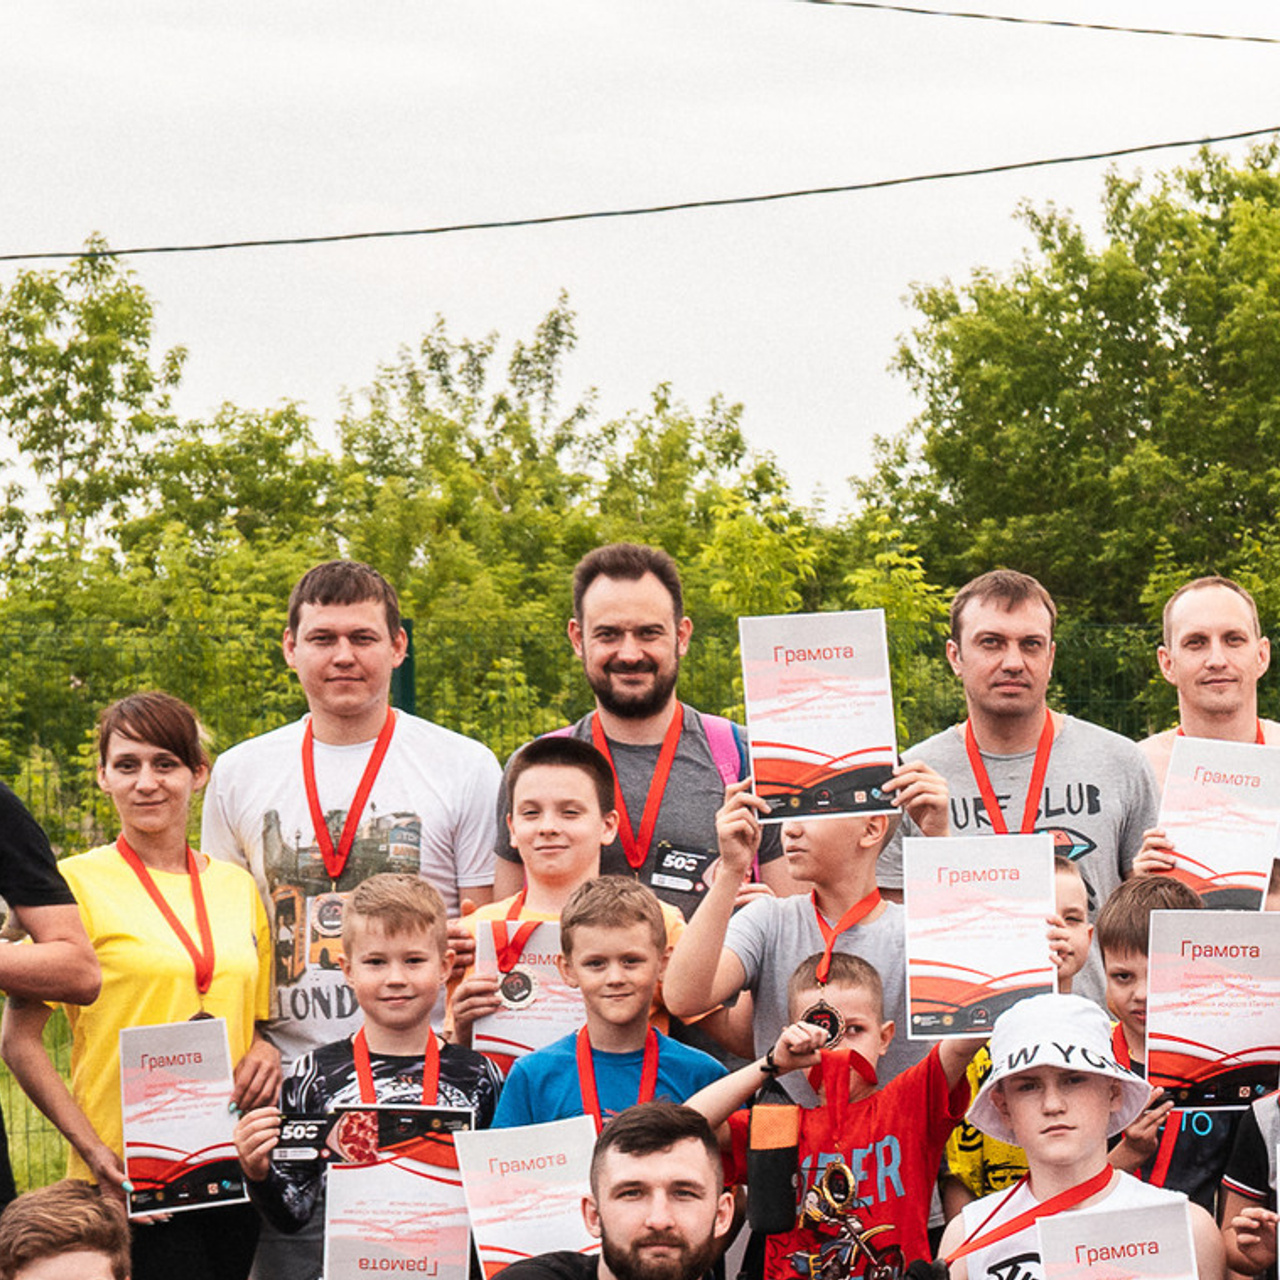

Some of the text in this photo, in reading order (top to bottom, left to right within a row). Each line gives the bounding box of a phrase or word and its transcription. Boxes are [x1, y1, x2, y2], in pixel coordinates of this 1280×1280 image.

[774, 646, 854, 667] Грамота
[1194, 766, 1261, 788] Грамота
[938, 867, 1020, 886] Грамота
[1181, 940, 1260, 961] Грамота
[141, 1052, 203, 1071] Грамота
[488, 1153, 567, 1177] Грамота
[1075, 1241, 1160, 1267] Грамота
[358, 1256, 438, 1277] Грамота
